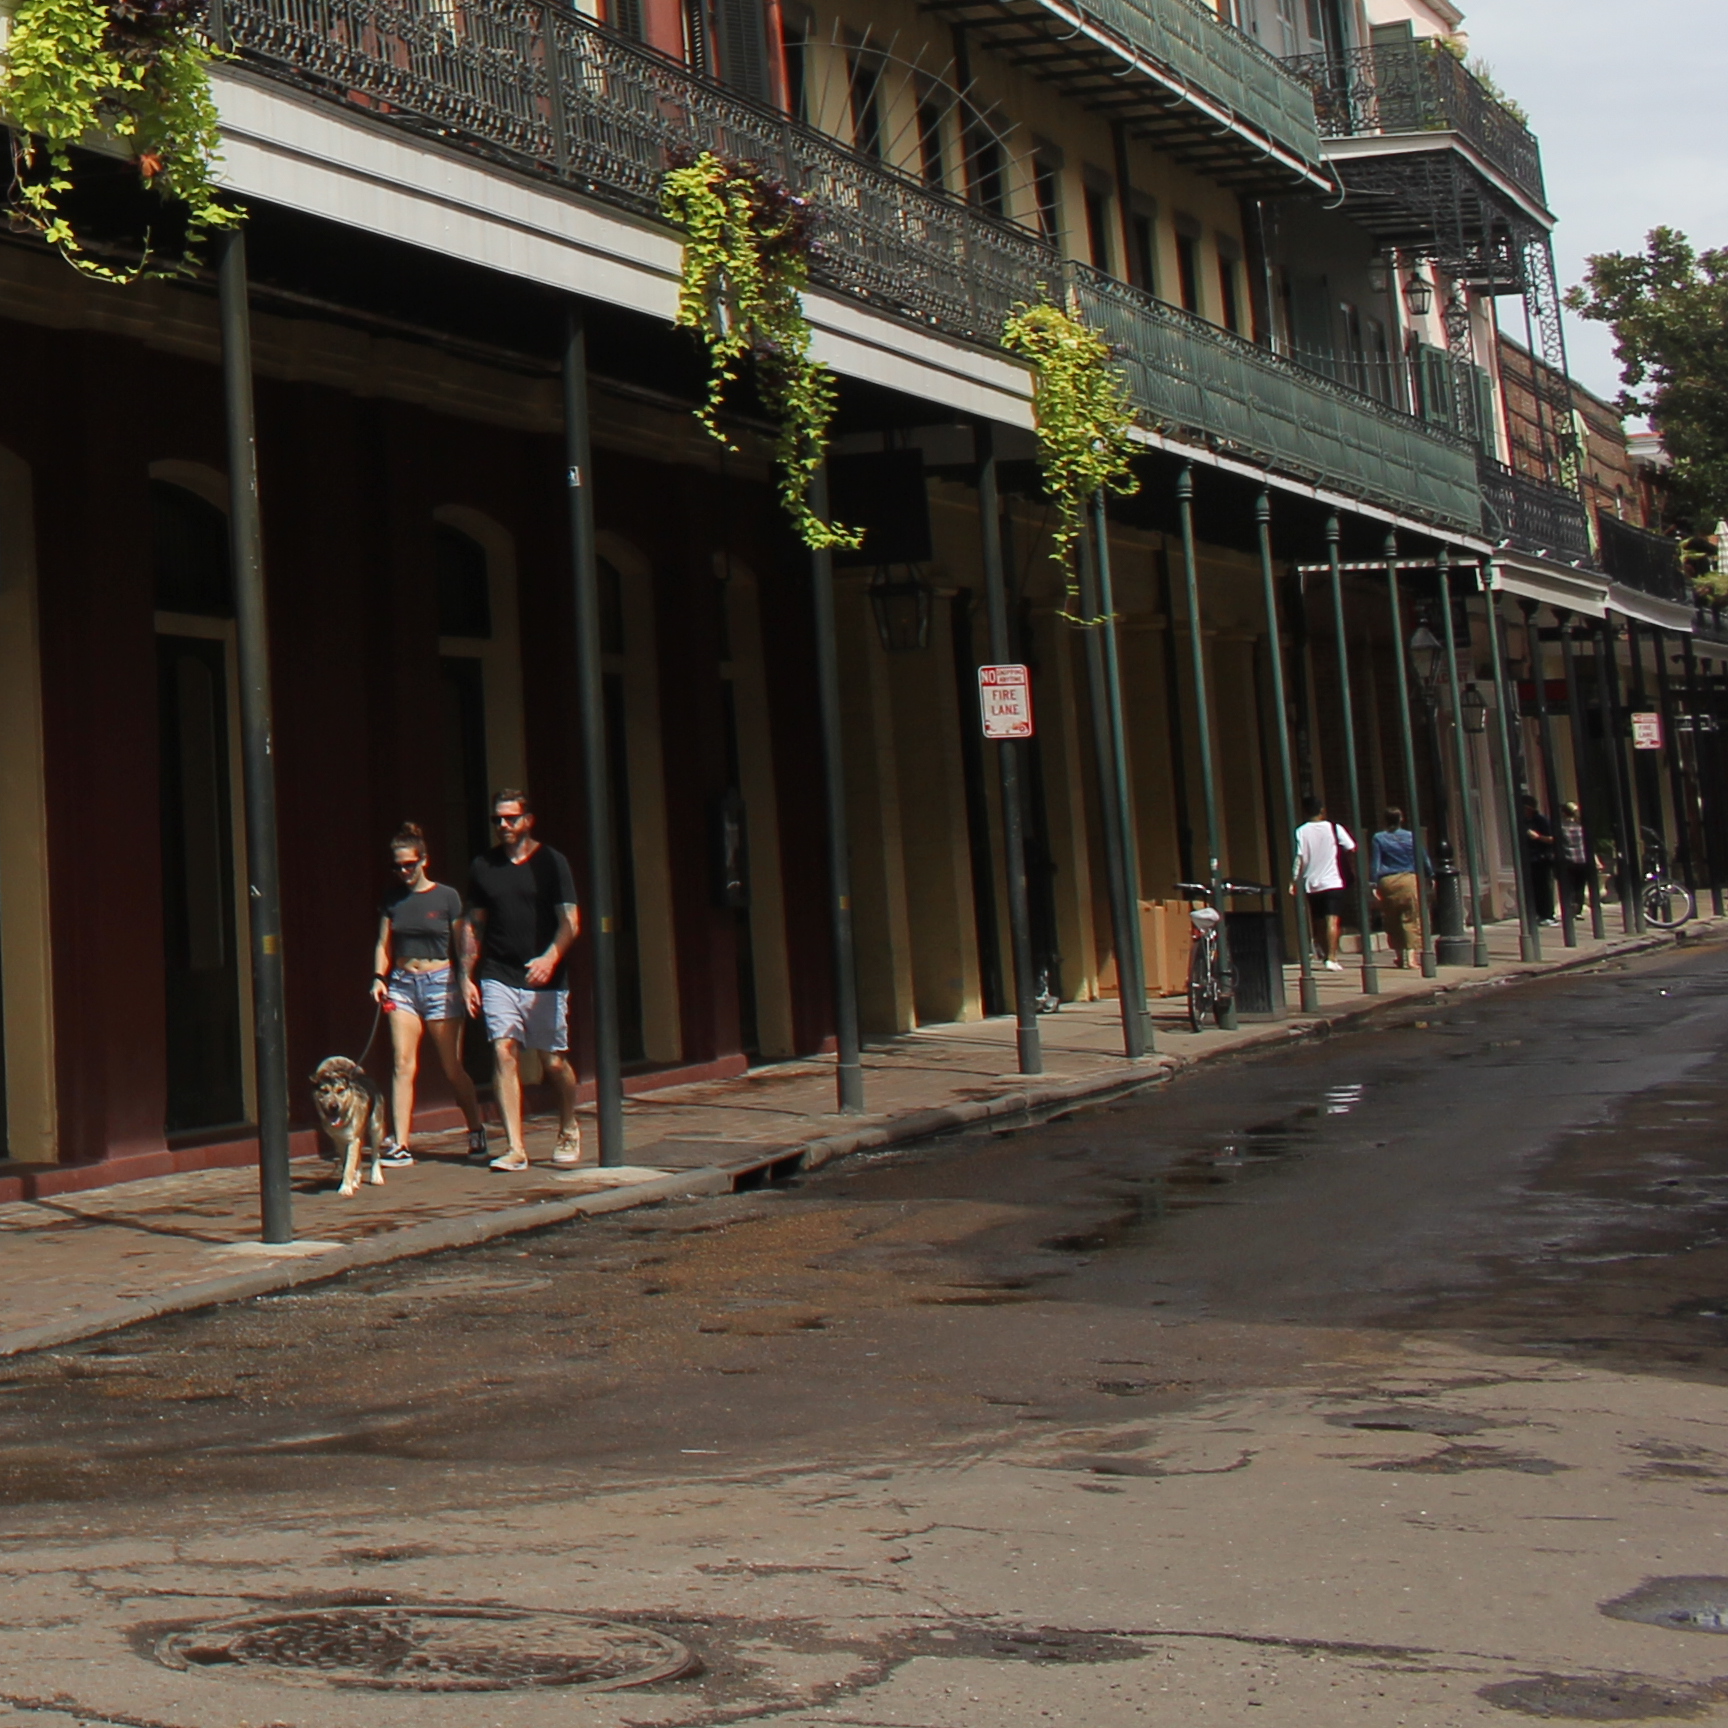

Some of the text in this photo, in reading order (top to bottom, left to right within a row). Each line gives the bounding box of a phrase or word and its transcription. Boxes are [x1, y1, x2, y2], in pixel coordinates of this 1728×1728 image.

[981, 669, 996, 683] NO
[992, 689, 1017, 700] FIRE
[991, 704, 1020, 716] LANE
